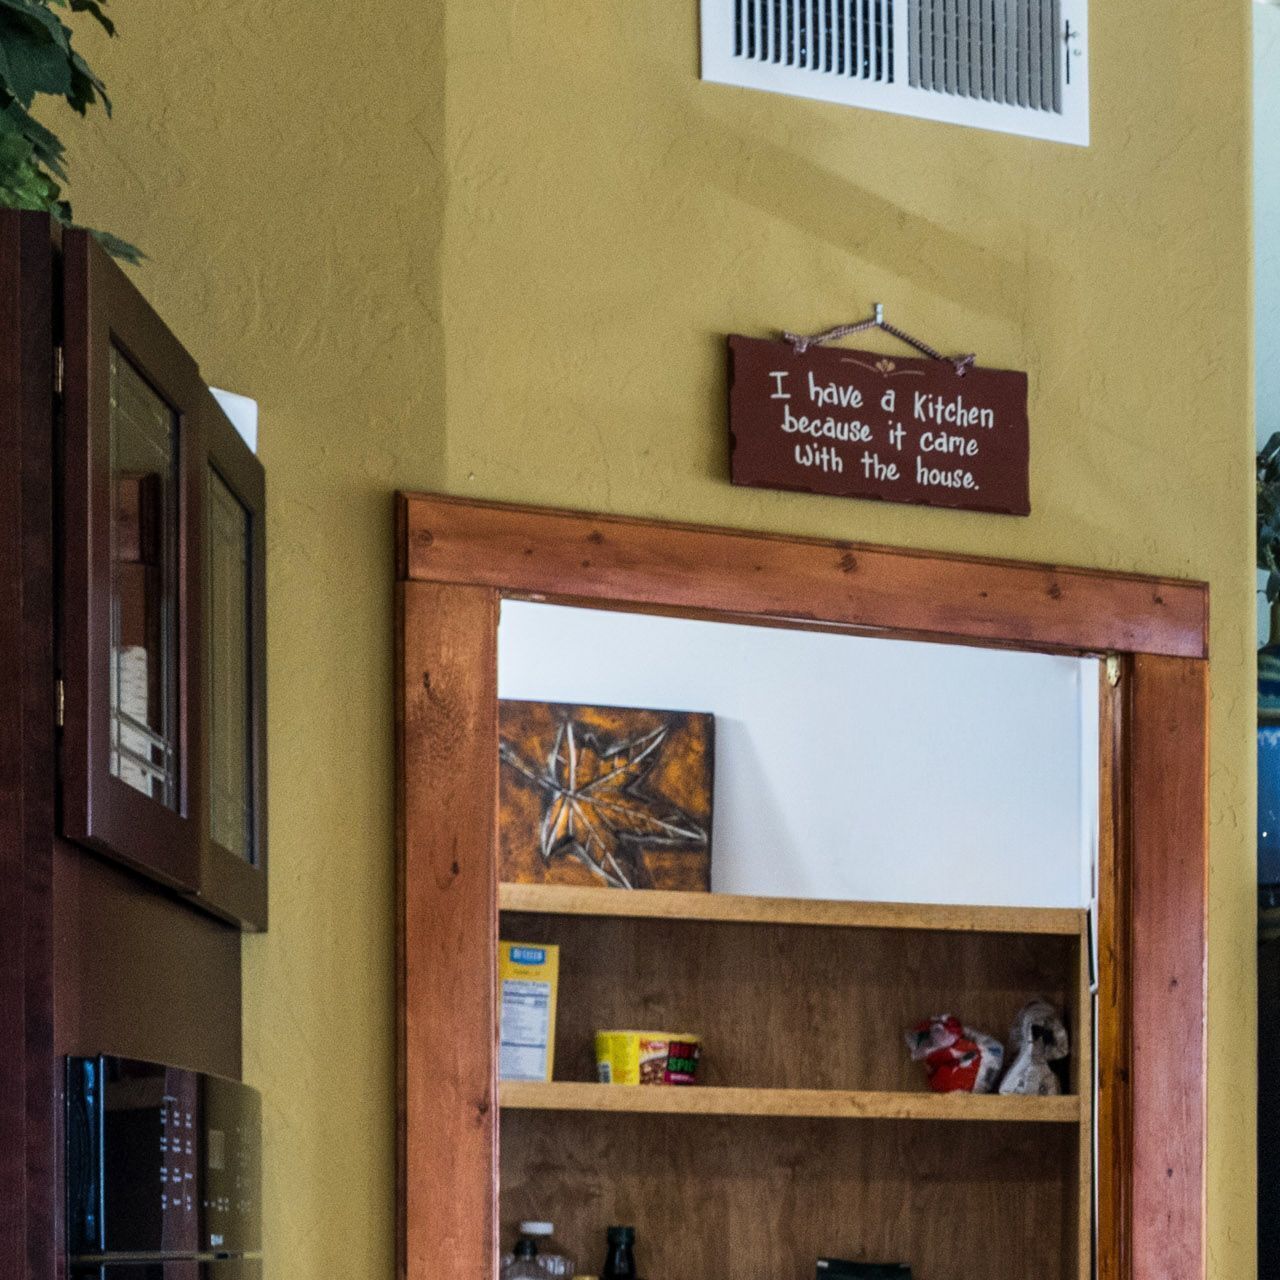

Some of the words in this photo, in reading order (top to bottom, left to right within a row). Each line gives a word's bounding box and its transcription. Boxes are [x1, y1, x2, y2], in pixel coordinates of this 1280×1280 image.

[769, 371, 791, 399] I
[808, 371, 863, 409] have
[880, 389, 895, 412] a
[781, 404, 873, 442] because
[888, 420, 906, 450] it
[919, 431, 979, 456] came
[861, 451, 900, 481] the
[916, 457, 980, 490] house.
